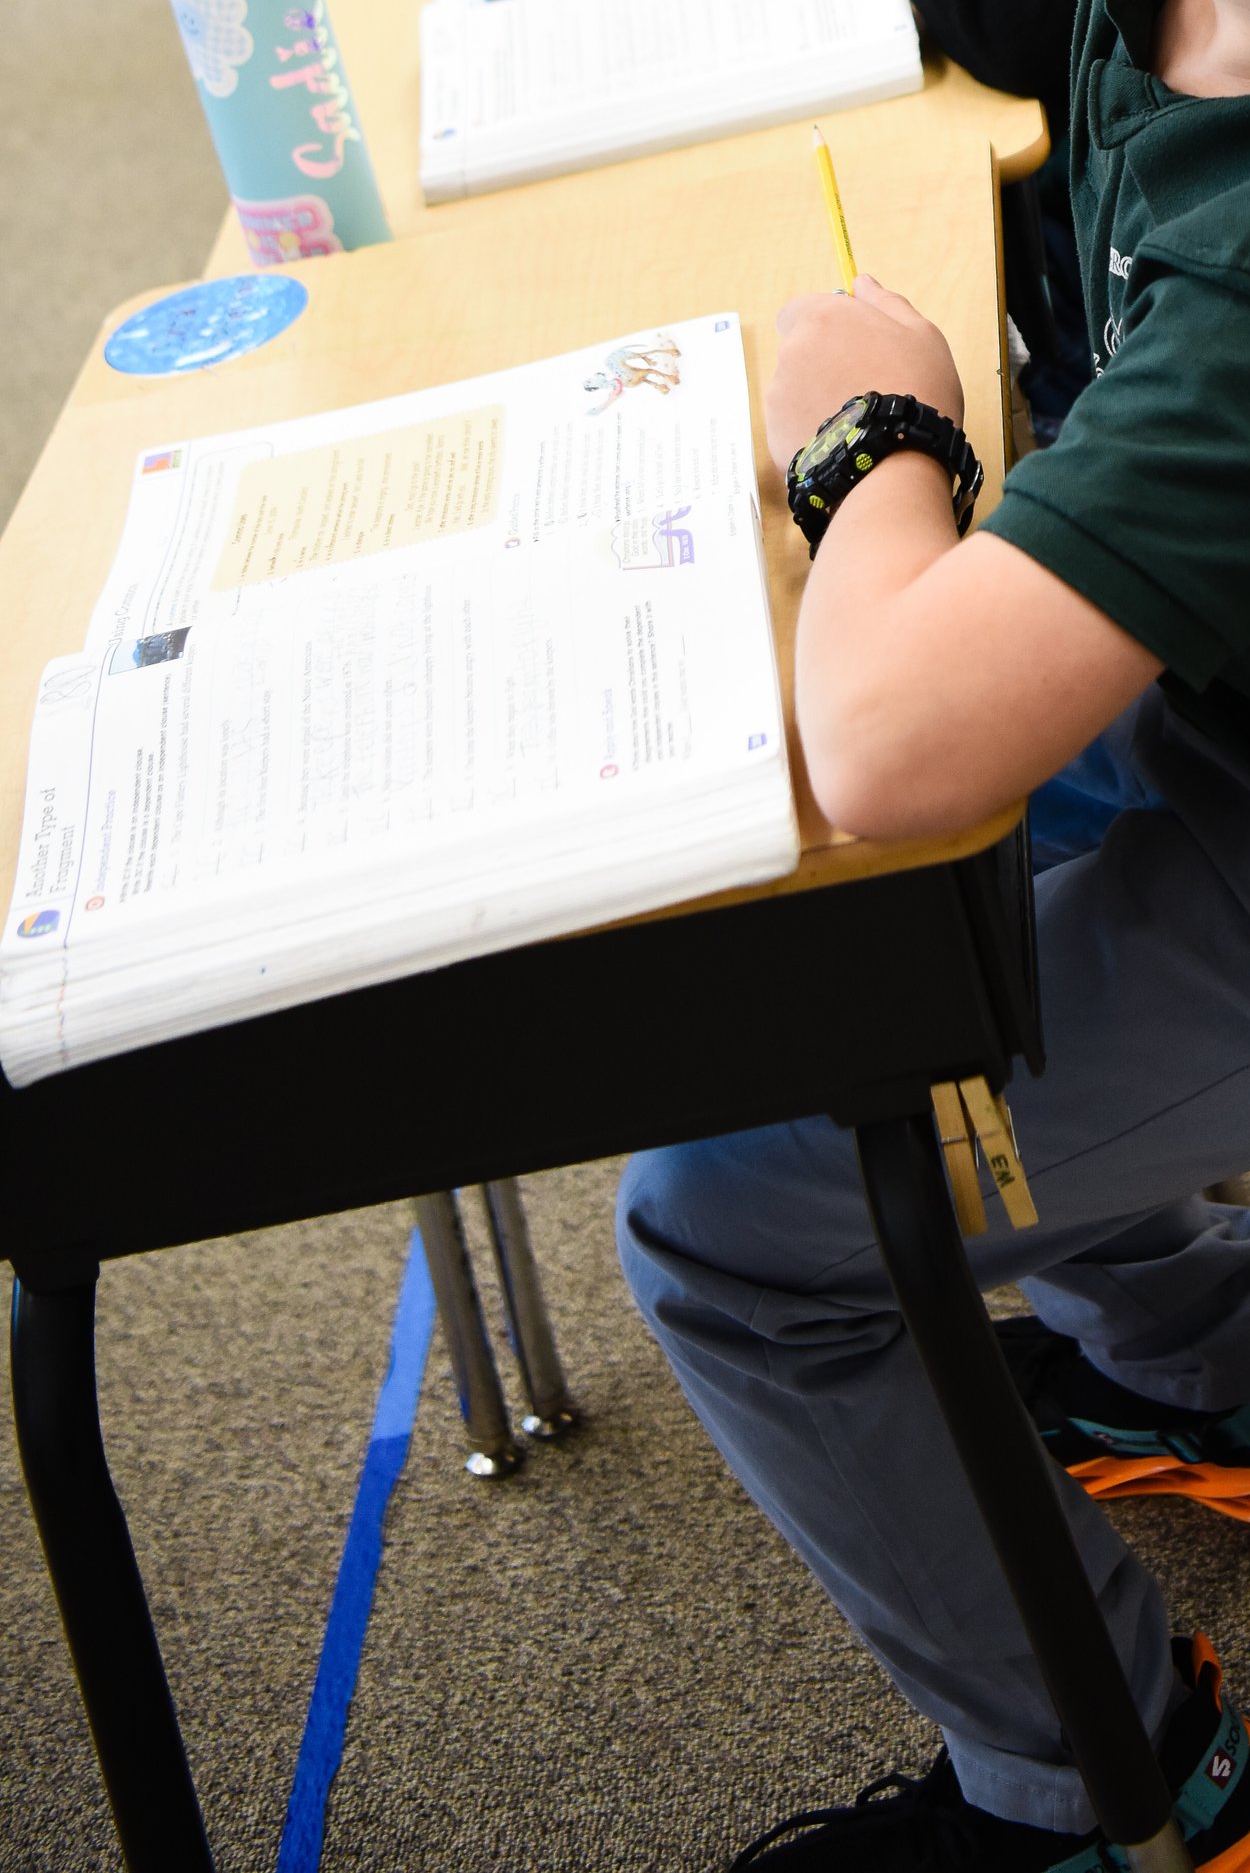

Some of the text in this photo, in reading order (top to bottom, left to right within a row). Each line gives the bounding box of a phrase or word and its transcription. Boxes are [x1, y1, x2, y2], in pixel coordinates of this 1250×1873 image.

[25, 785, 58, 899] Another Type of
[49, 823, 77, 895] Fragment
